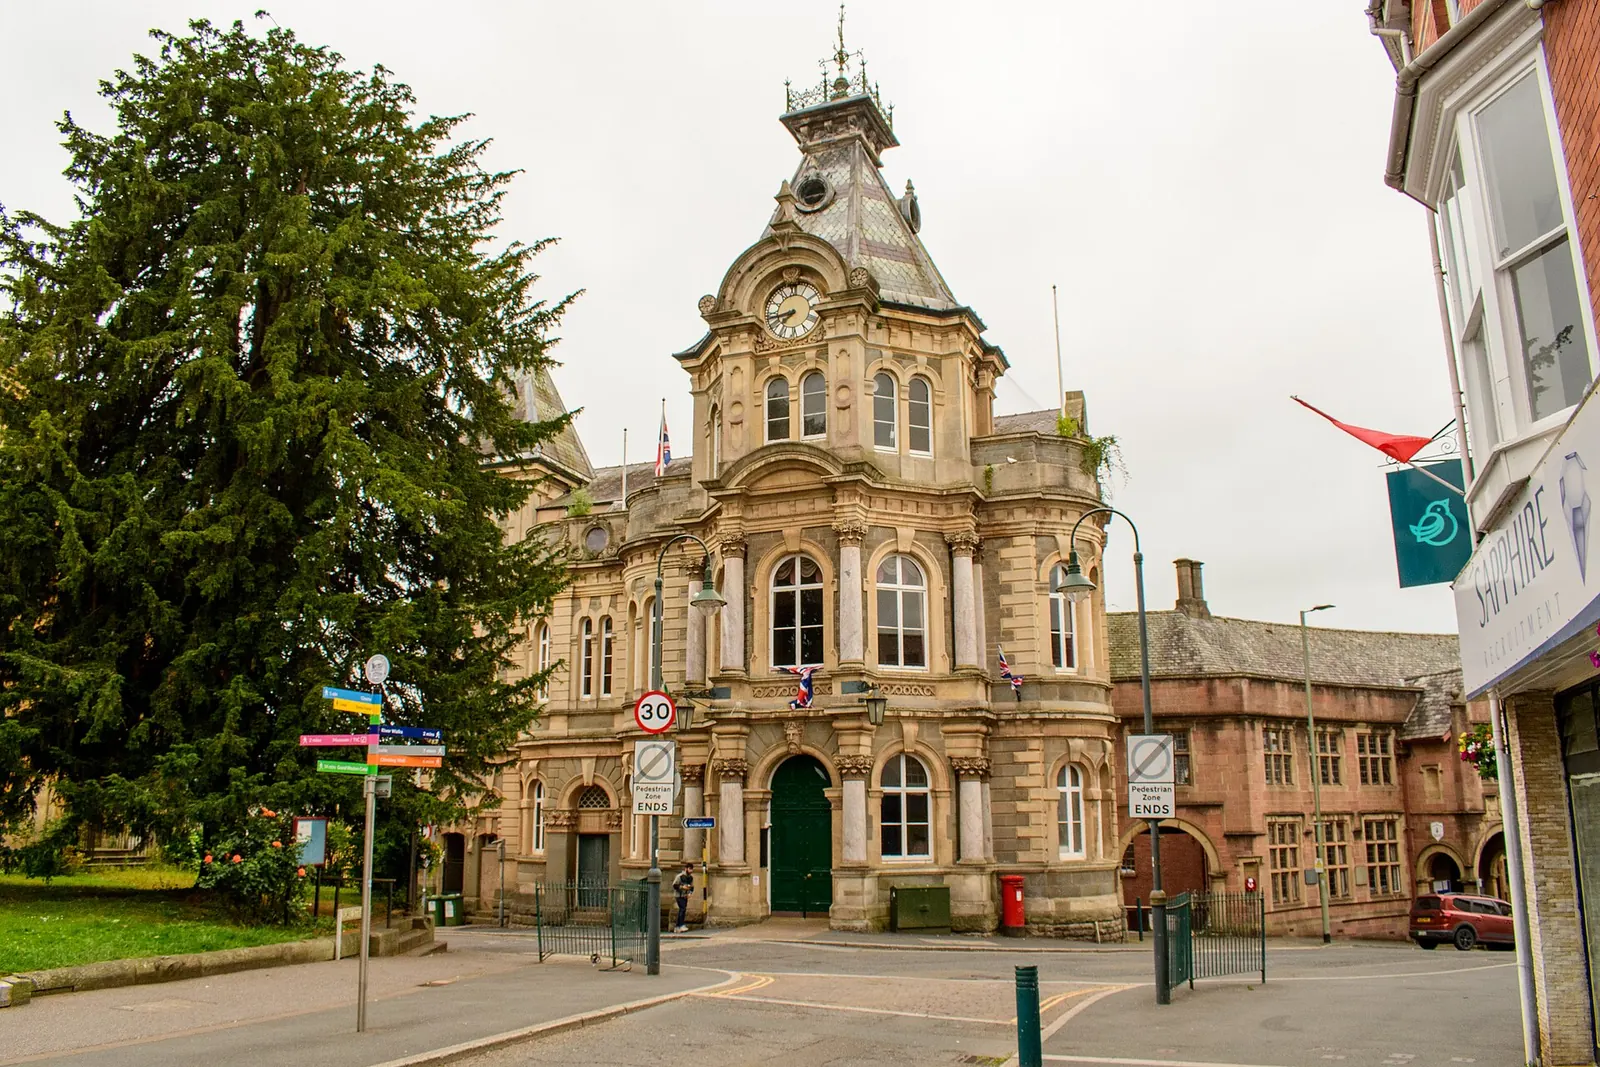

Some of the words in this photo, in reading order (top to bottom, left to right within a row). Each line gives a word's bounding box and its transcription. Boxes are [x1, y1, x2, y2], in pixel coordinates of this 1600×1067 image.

[1474, 485, 1554, 628] SAPPHIRE
[641, 703, 670, 721] 30
[1131, 785, 1172, 793] Pedestrian
[637, 803, 668, 812] ENDS
[1135, 804, 1170, 814] ENDS
